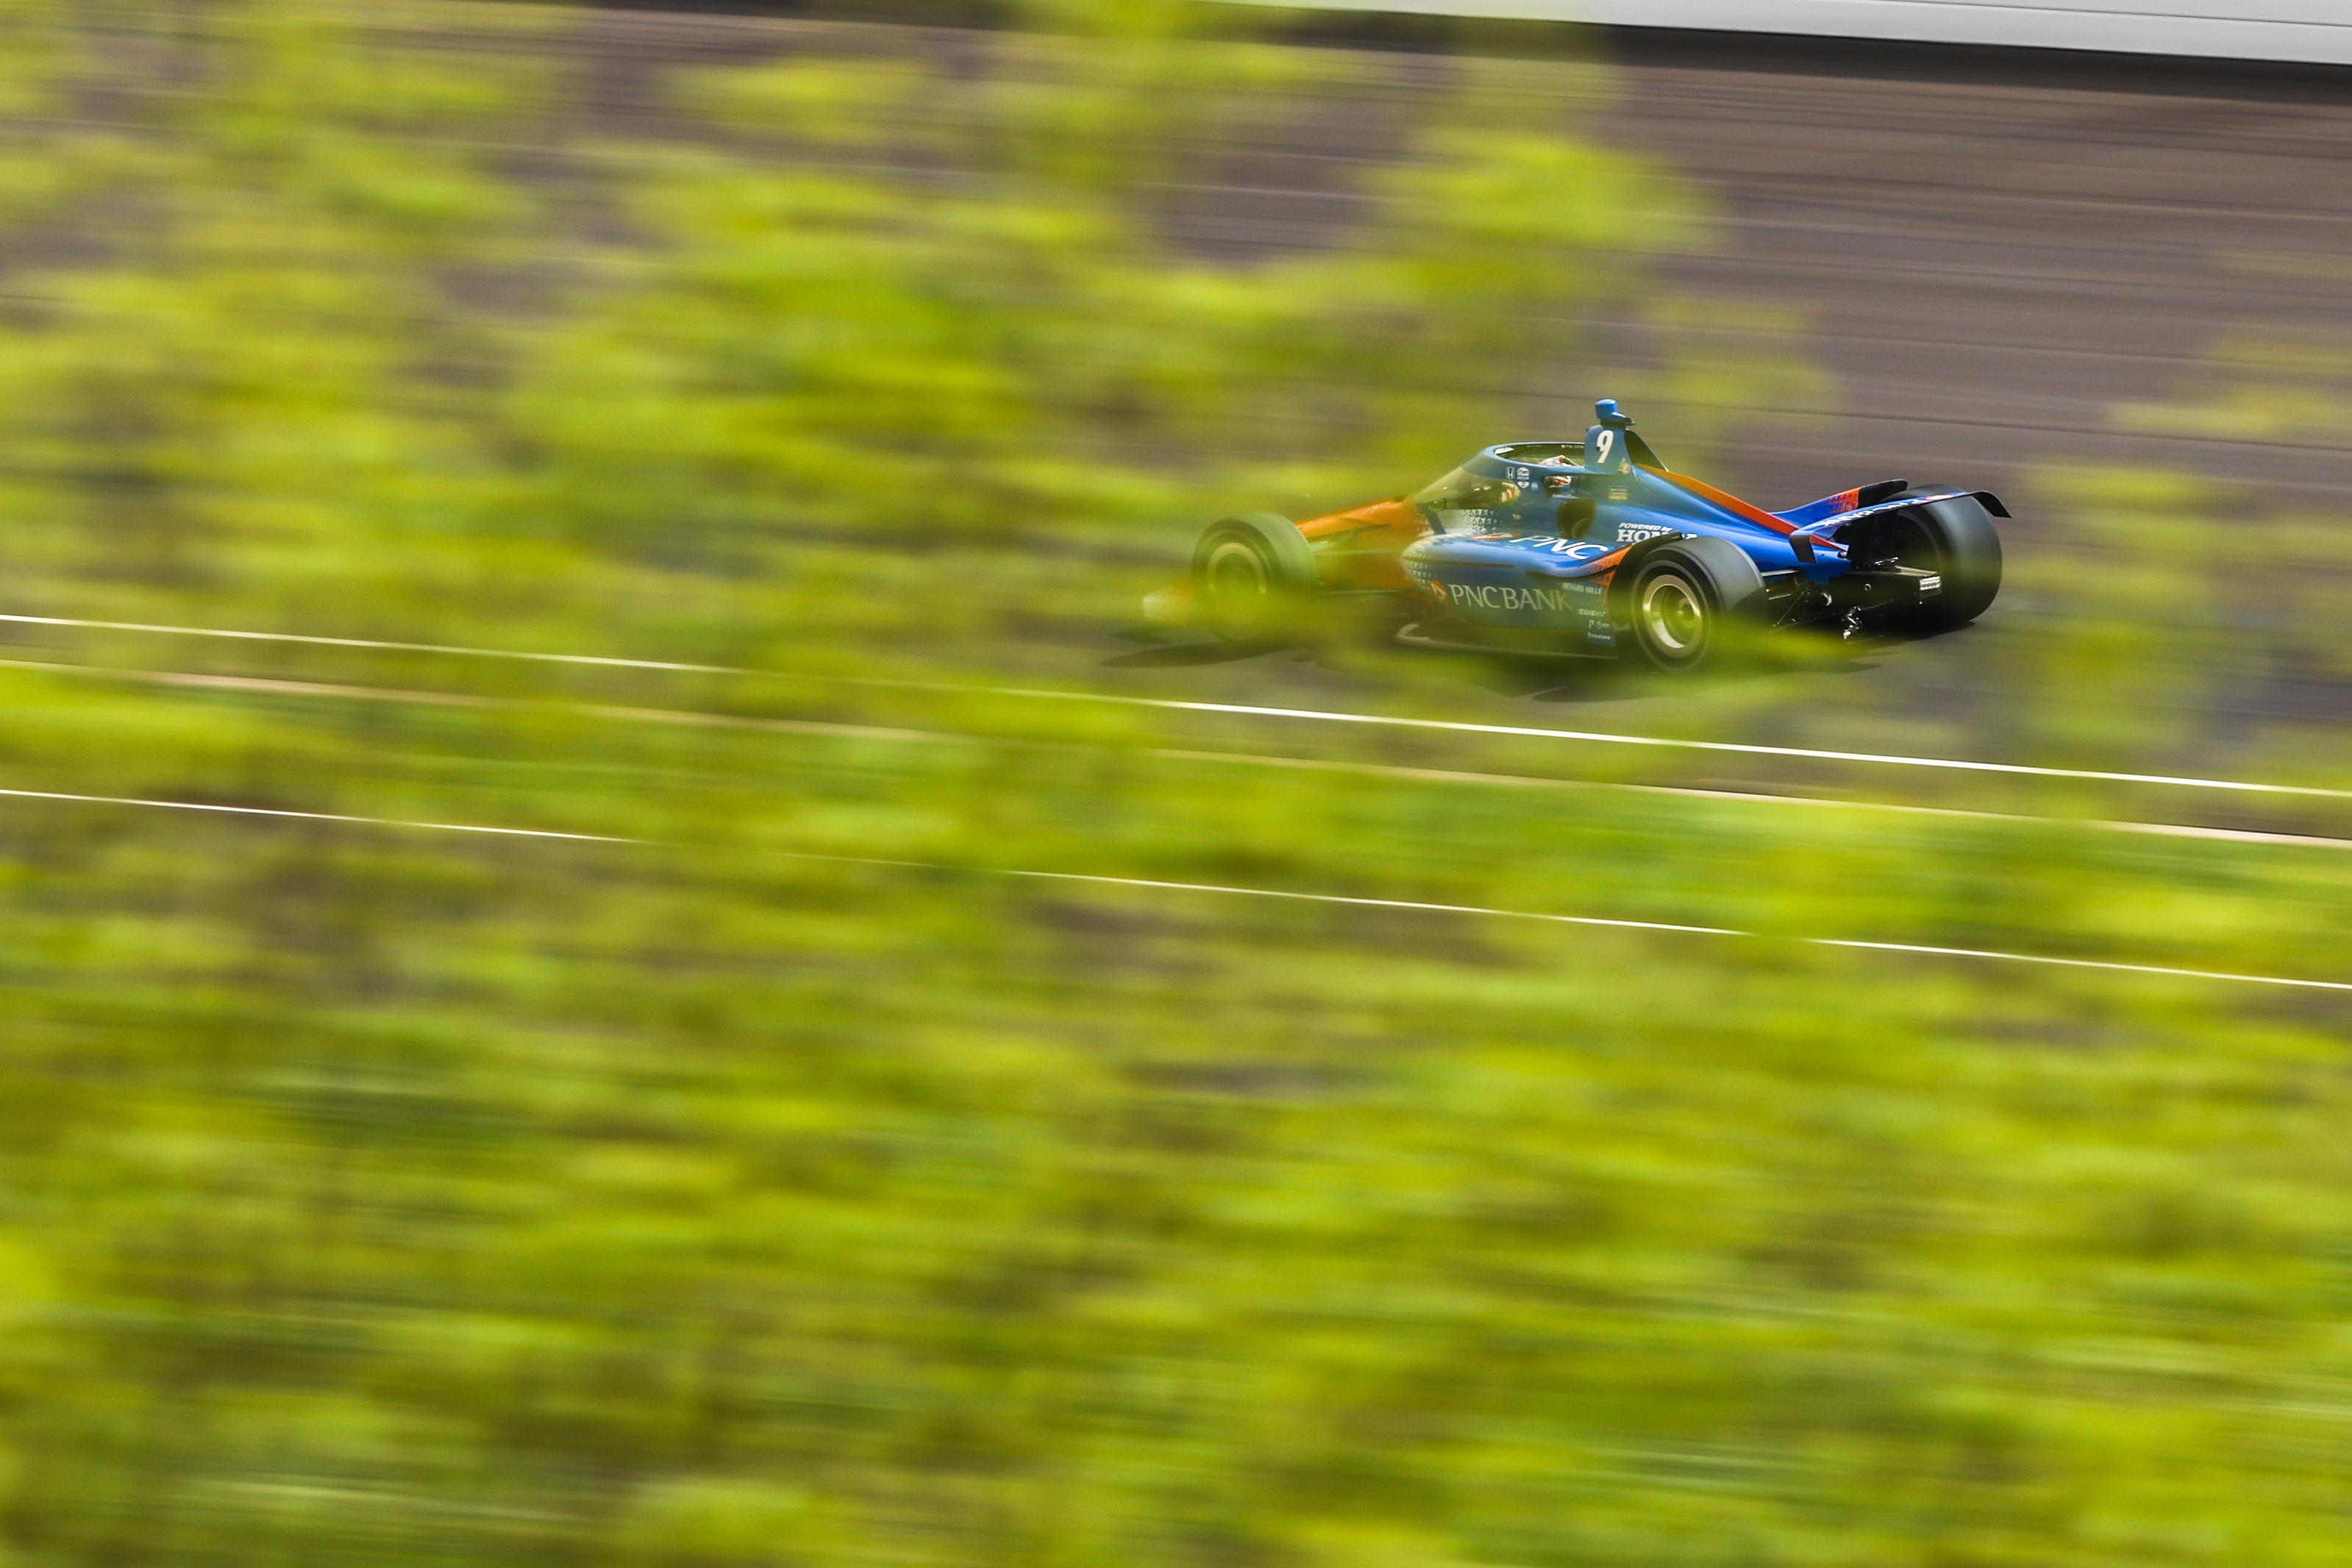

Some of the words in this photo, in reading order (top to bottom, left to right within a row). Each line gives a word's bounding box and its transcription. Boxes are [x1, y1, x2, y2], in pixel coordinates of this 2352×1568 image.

[1597, 430, 1614, 463] 9
[1619, 522, 1661, 530] POWERED
[1509, 535, 1608, 560] PNC
[1448, 584, 1501, 608] PNC
[1500, 587, 1573, 611] BANK
